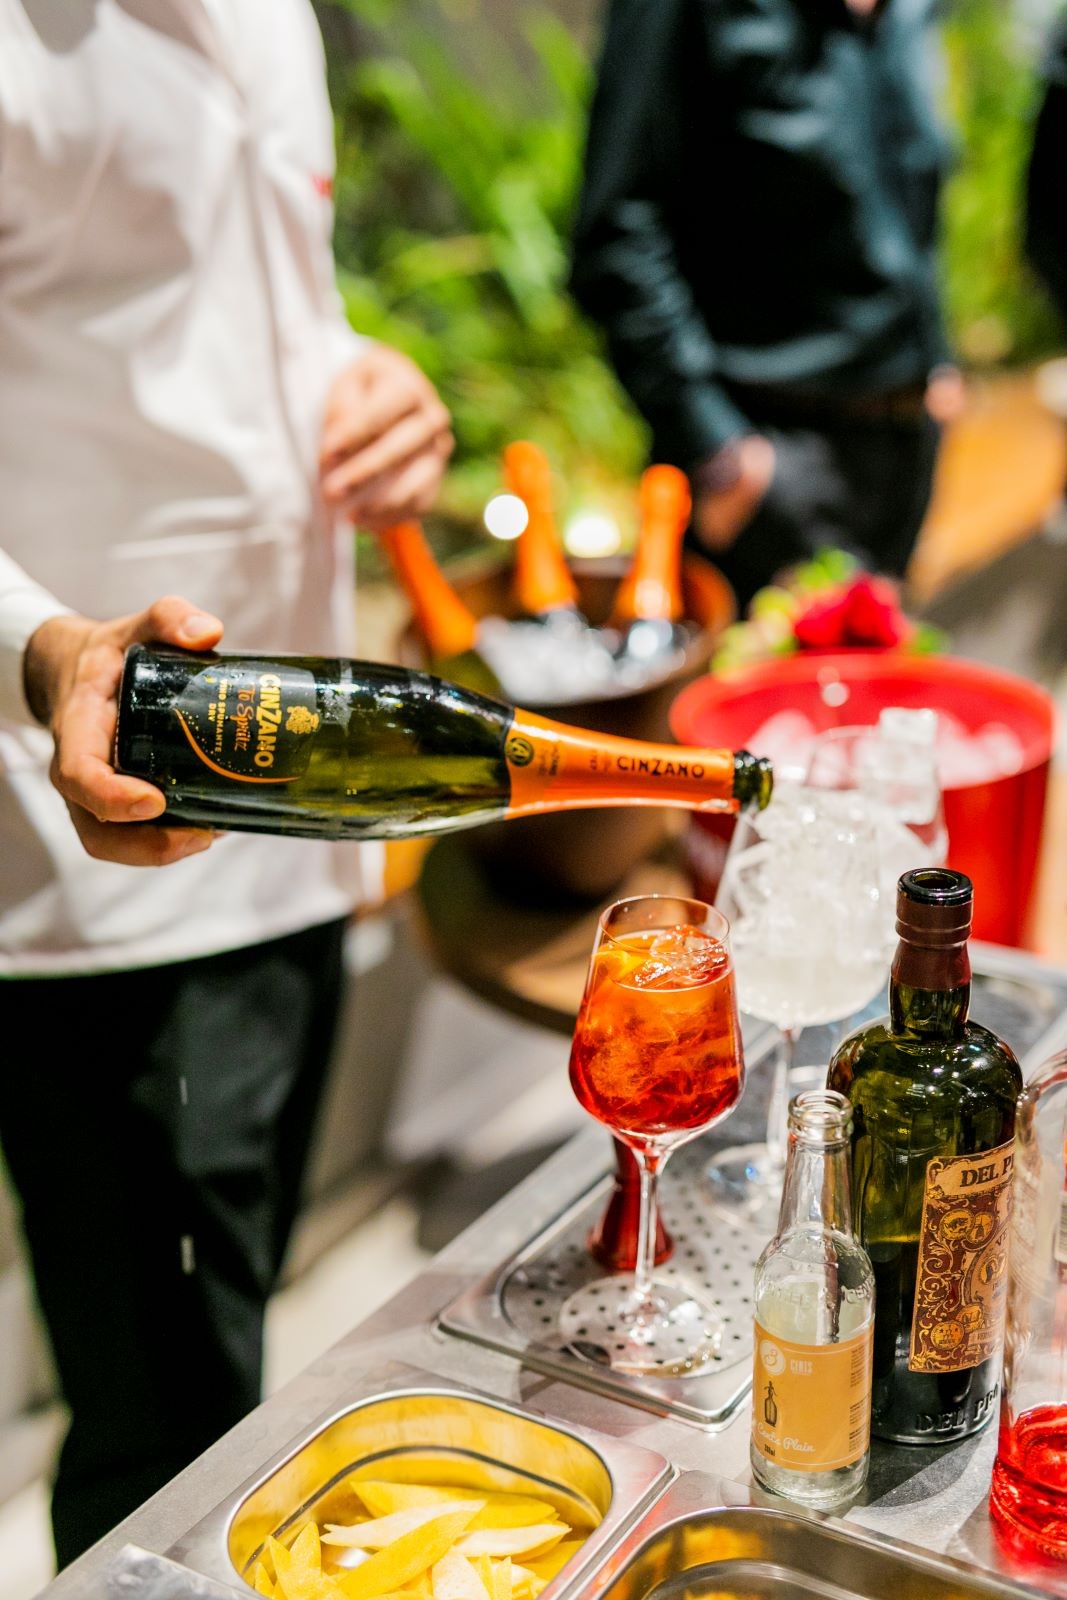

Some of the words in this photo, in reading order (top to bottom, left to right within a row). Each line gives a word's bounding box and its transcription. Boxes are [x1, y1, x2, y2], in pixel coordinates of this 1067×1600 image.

[219, 680, 227, 700] VINO
[208, 703, 216, 721] DRY
[254, 674, 282, 767] CINZANO
[215, 702, 226, 752] SPUMANTE
[617, 756, 705, 779] CINZANO
[960, 1163, 999, 1188] DEL
[915, 1409, 967, 1434] DEL
